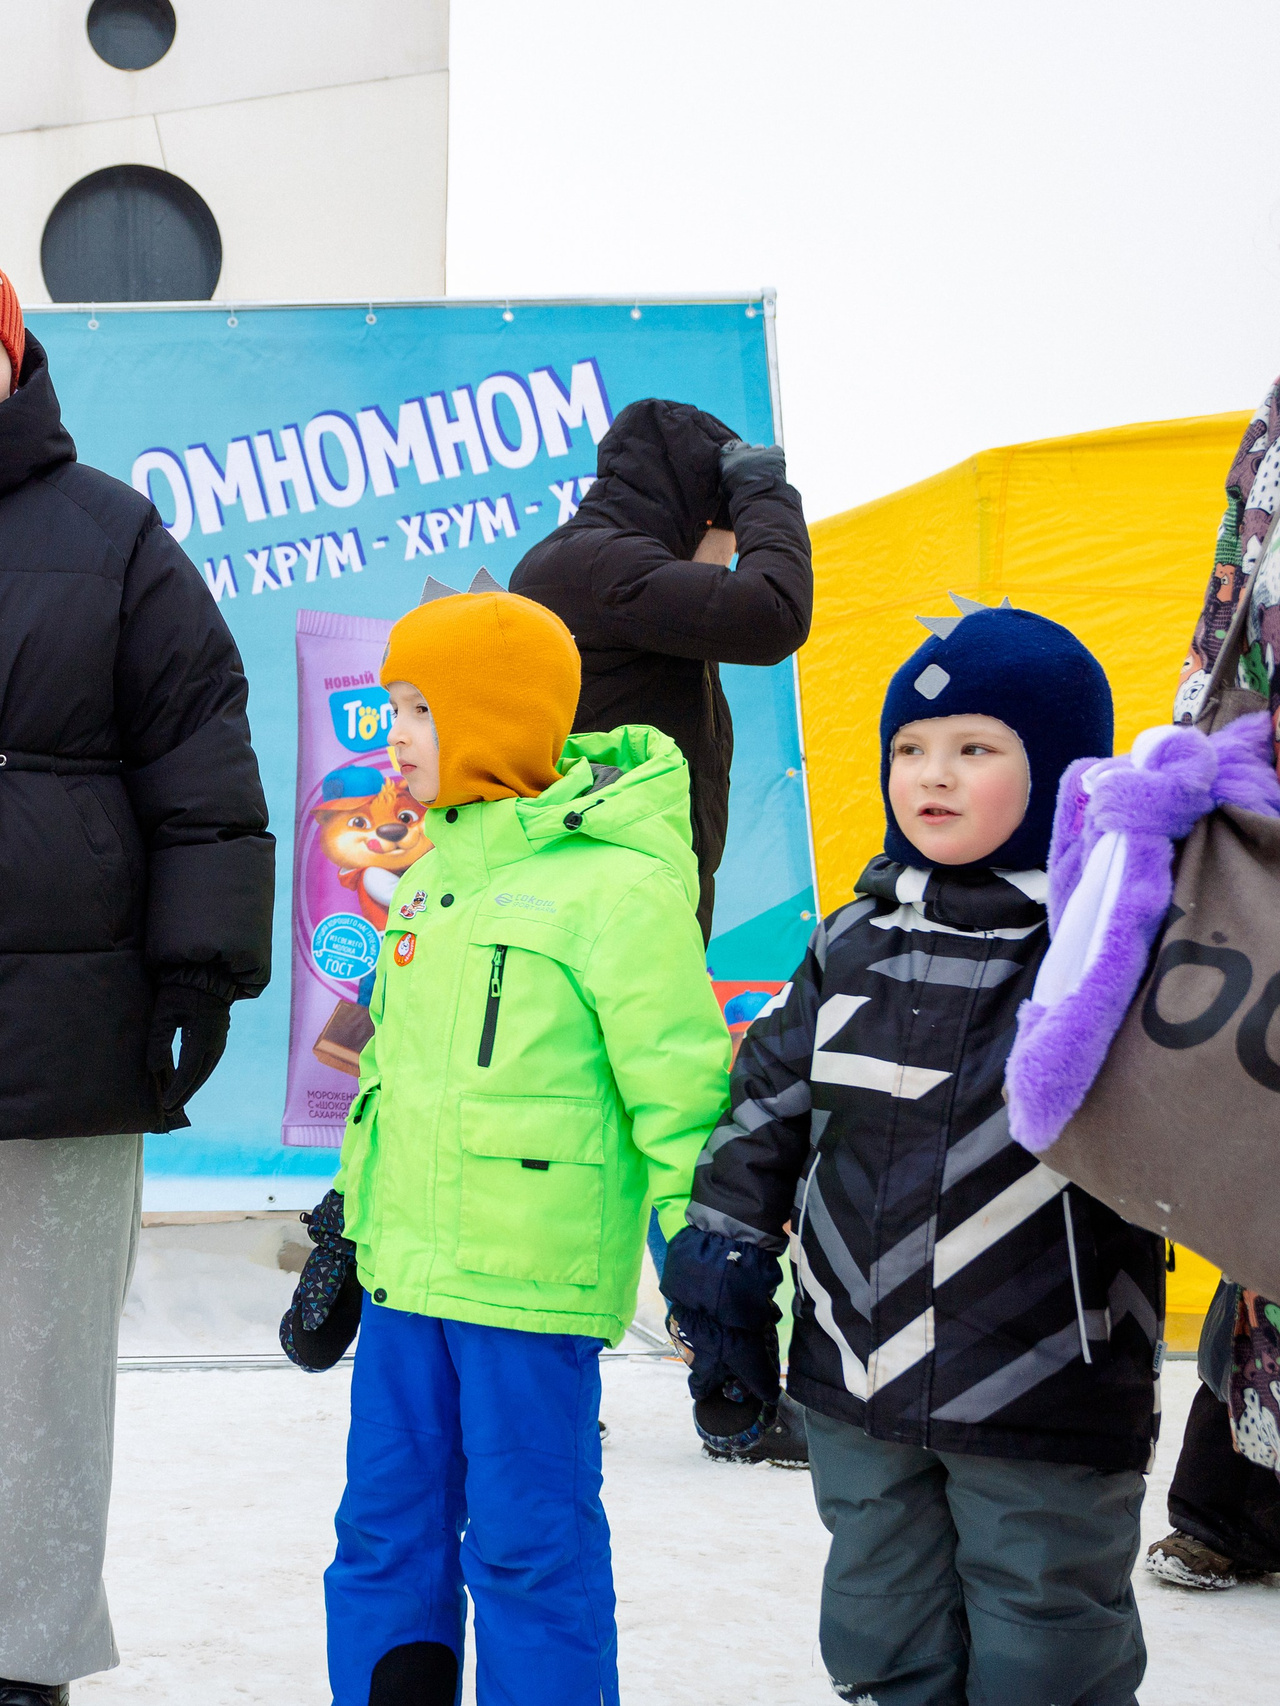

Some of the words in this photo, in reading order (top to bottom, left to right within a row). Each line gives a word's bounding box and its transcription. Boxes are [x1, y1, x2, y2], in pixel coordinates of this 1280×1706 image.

[131, 357, 613, 543] ОМНОМНОМ
[203, 555, 238, 602] И
[244, 527, 367, 595] ХРУМ
[396, 492, 520, 561] ХРУМ
[323, 670, 375, 690] НОВЫЙ
[324, 958, 355, 977] ГОСТ
